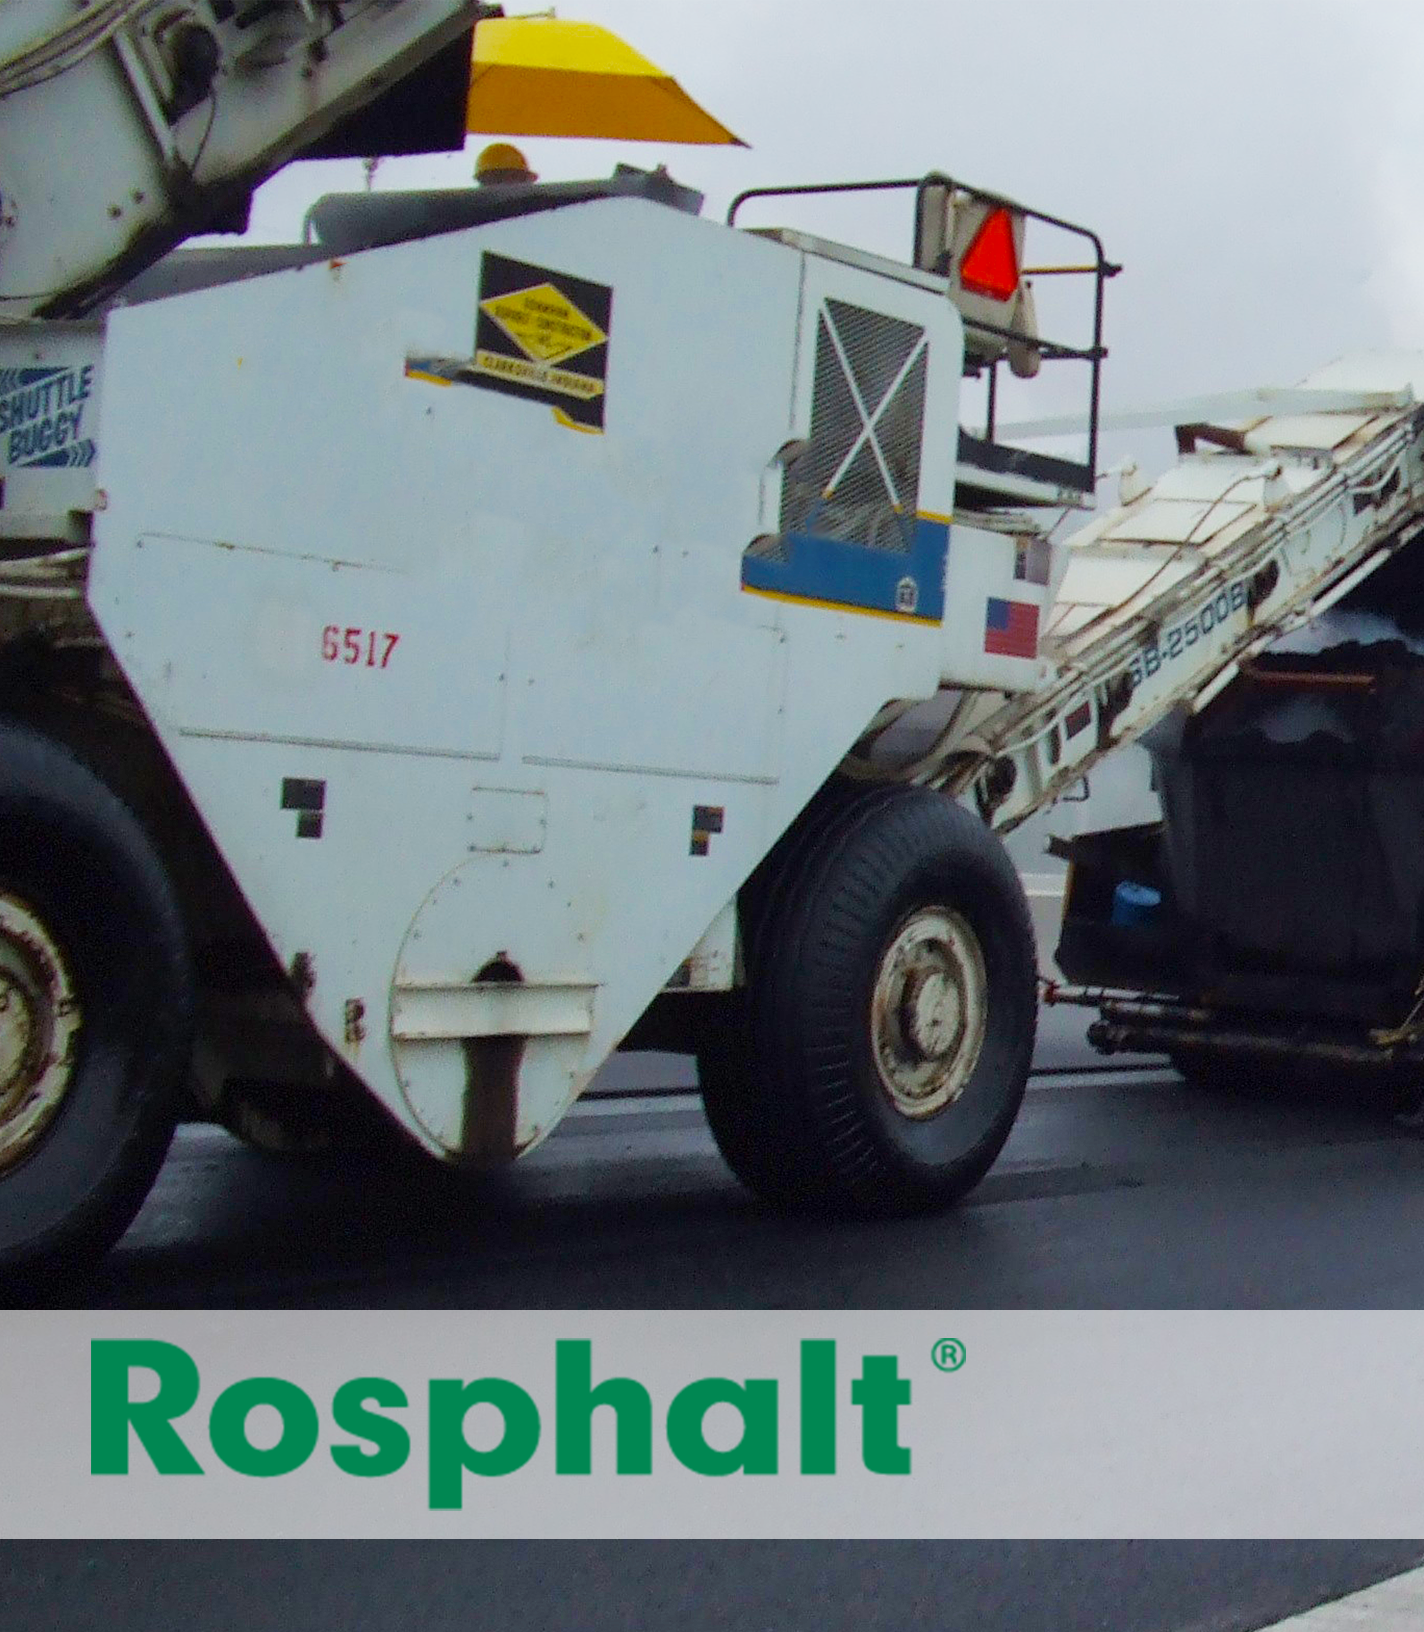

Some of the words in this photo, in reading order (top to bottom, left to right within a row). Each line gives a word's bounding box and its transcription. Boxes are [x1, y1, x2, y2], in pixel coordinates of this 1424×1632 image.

[0, 365, 94, 436] SHUTTLE
[8, 403, 84, 465] BUGGY
[322, 624, 400, 669] 6517
